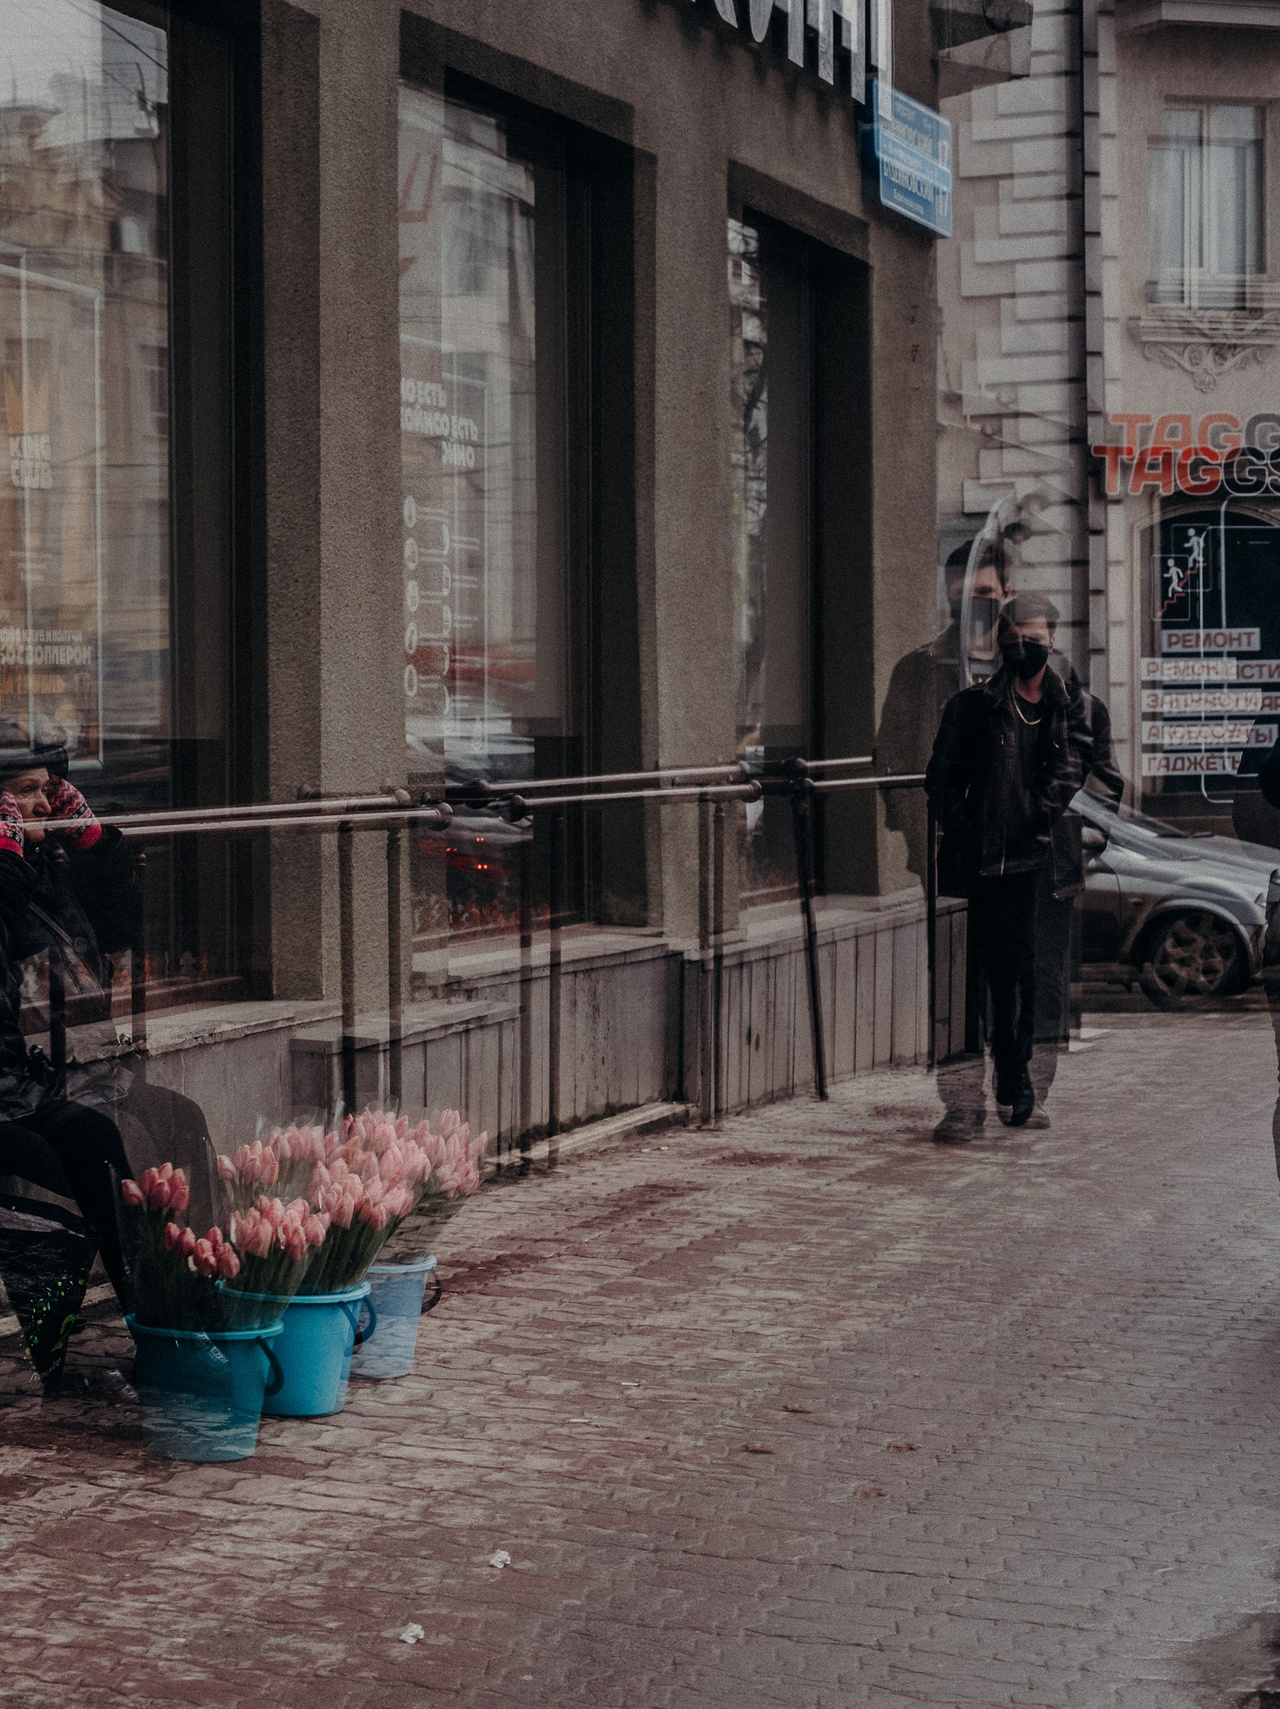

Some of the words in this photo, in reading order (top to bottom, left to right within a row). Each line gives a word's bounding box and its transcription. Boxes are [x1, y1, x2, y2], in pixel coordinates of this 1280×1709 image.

[9, 433, 51, 460] KING
[10, 458, 53, 489] CLUB
[1167, 631, 1256, 650] РЕМОНТ
